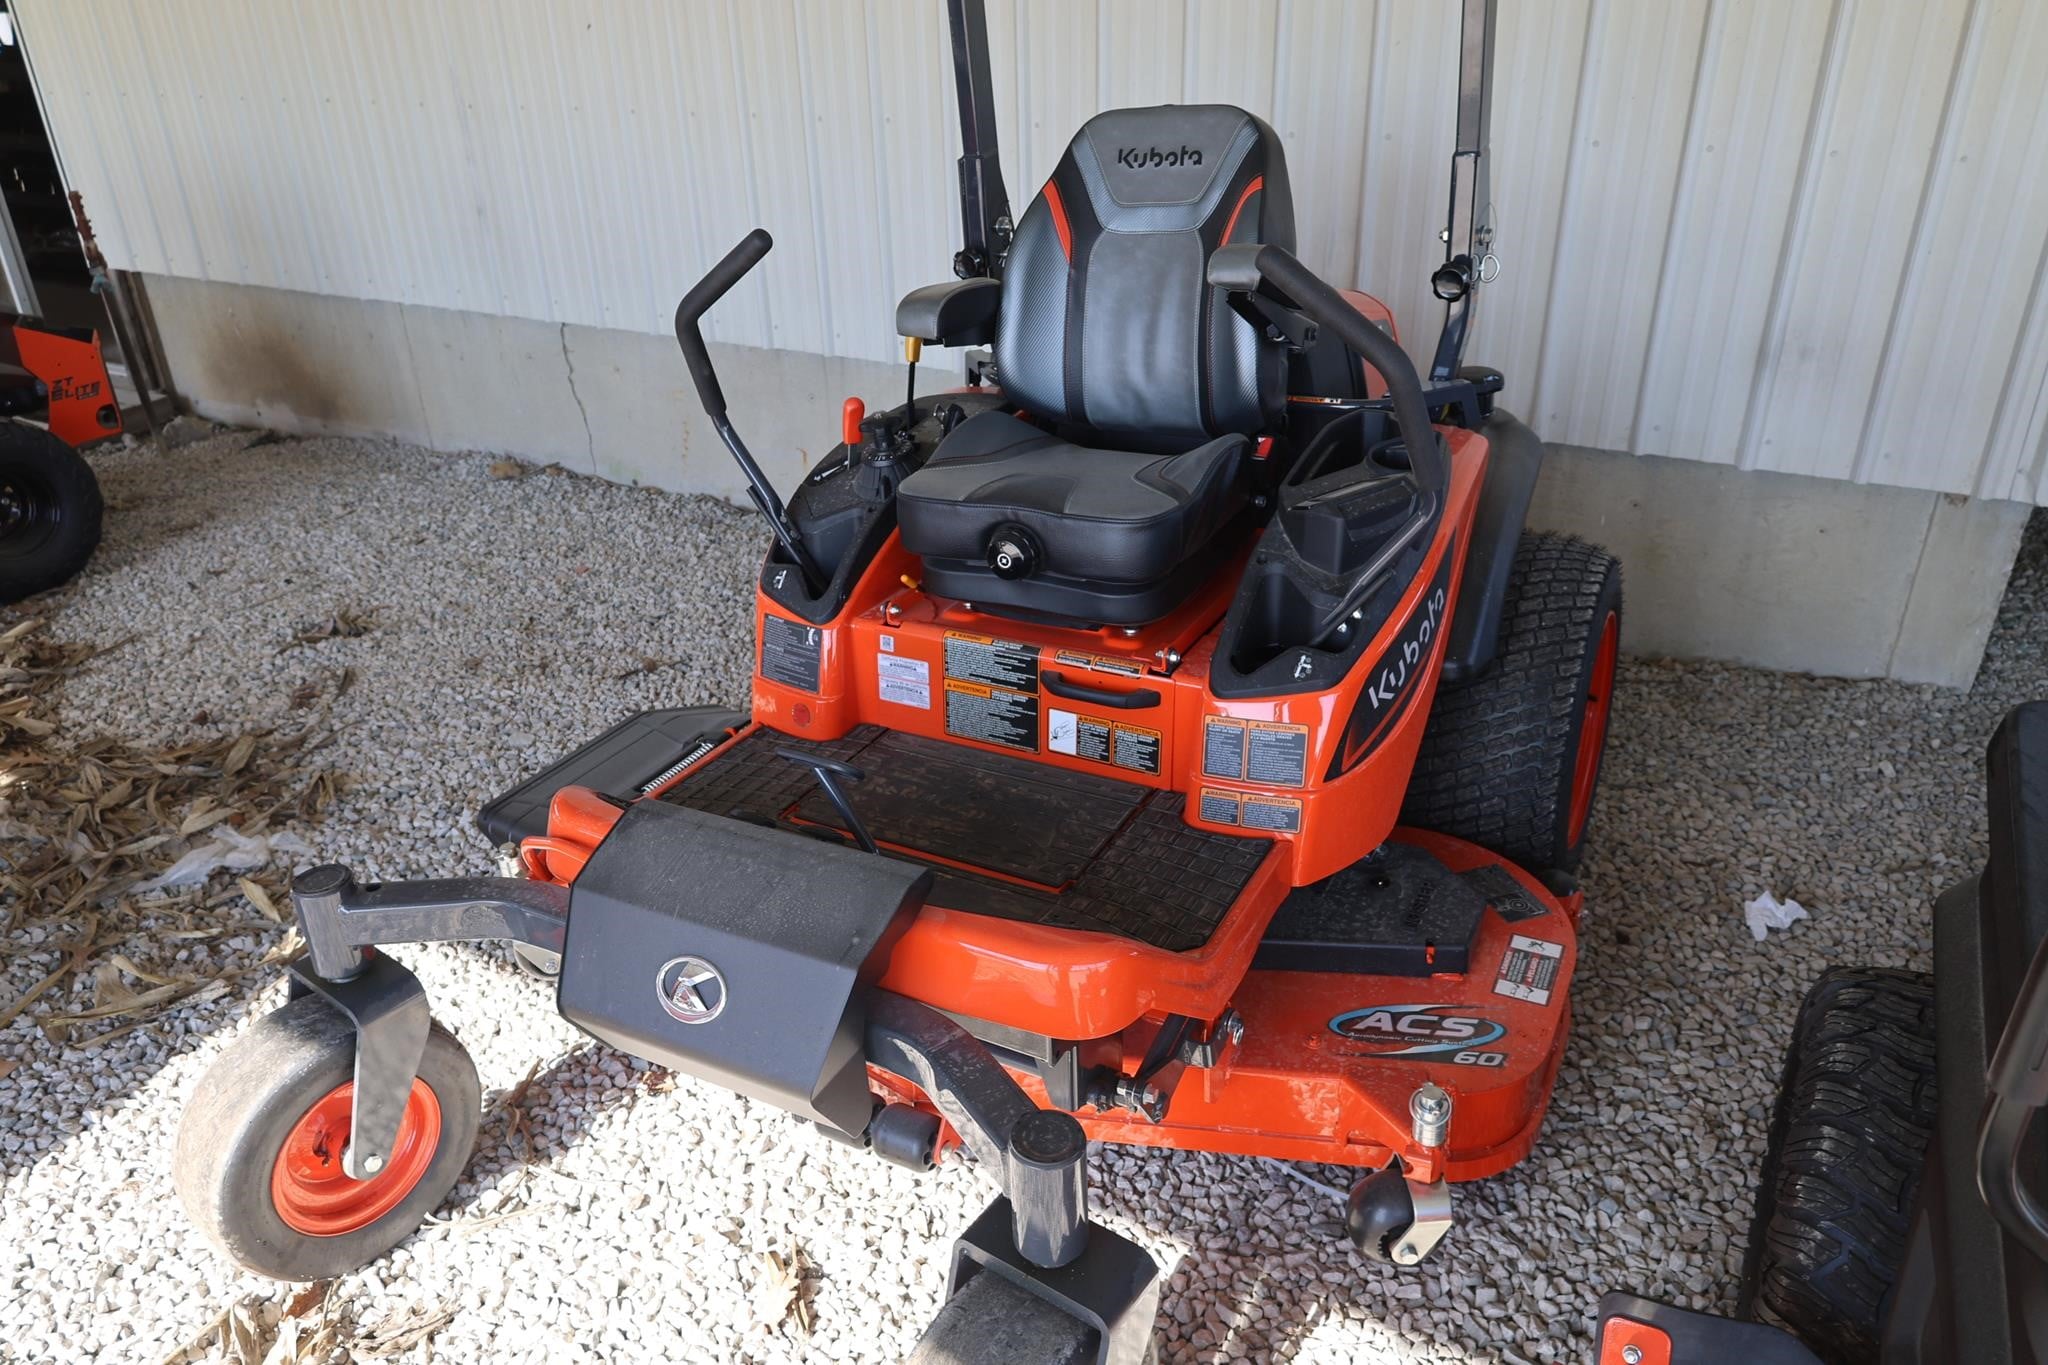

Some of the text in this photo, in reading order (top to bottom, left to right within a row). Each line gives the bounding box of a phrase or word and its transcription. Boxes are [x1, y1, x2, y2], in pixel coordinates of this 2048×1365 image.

[1117, 144, 1204, 170] Kubota
[1367, 587, 1445, 710] Kubota
[1253, 796, 1296, 806] ADVERTENCIA
[1353, 1012, 1479, 1037] ACS
[1453, 1052, 1505, 1067] 60
